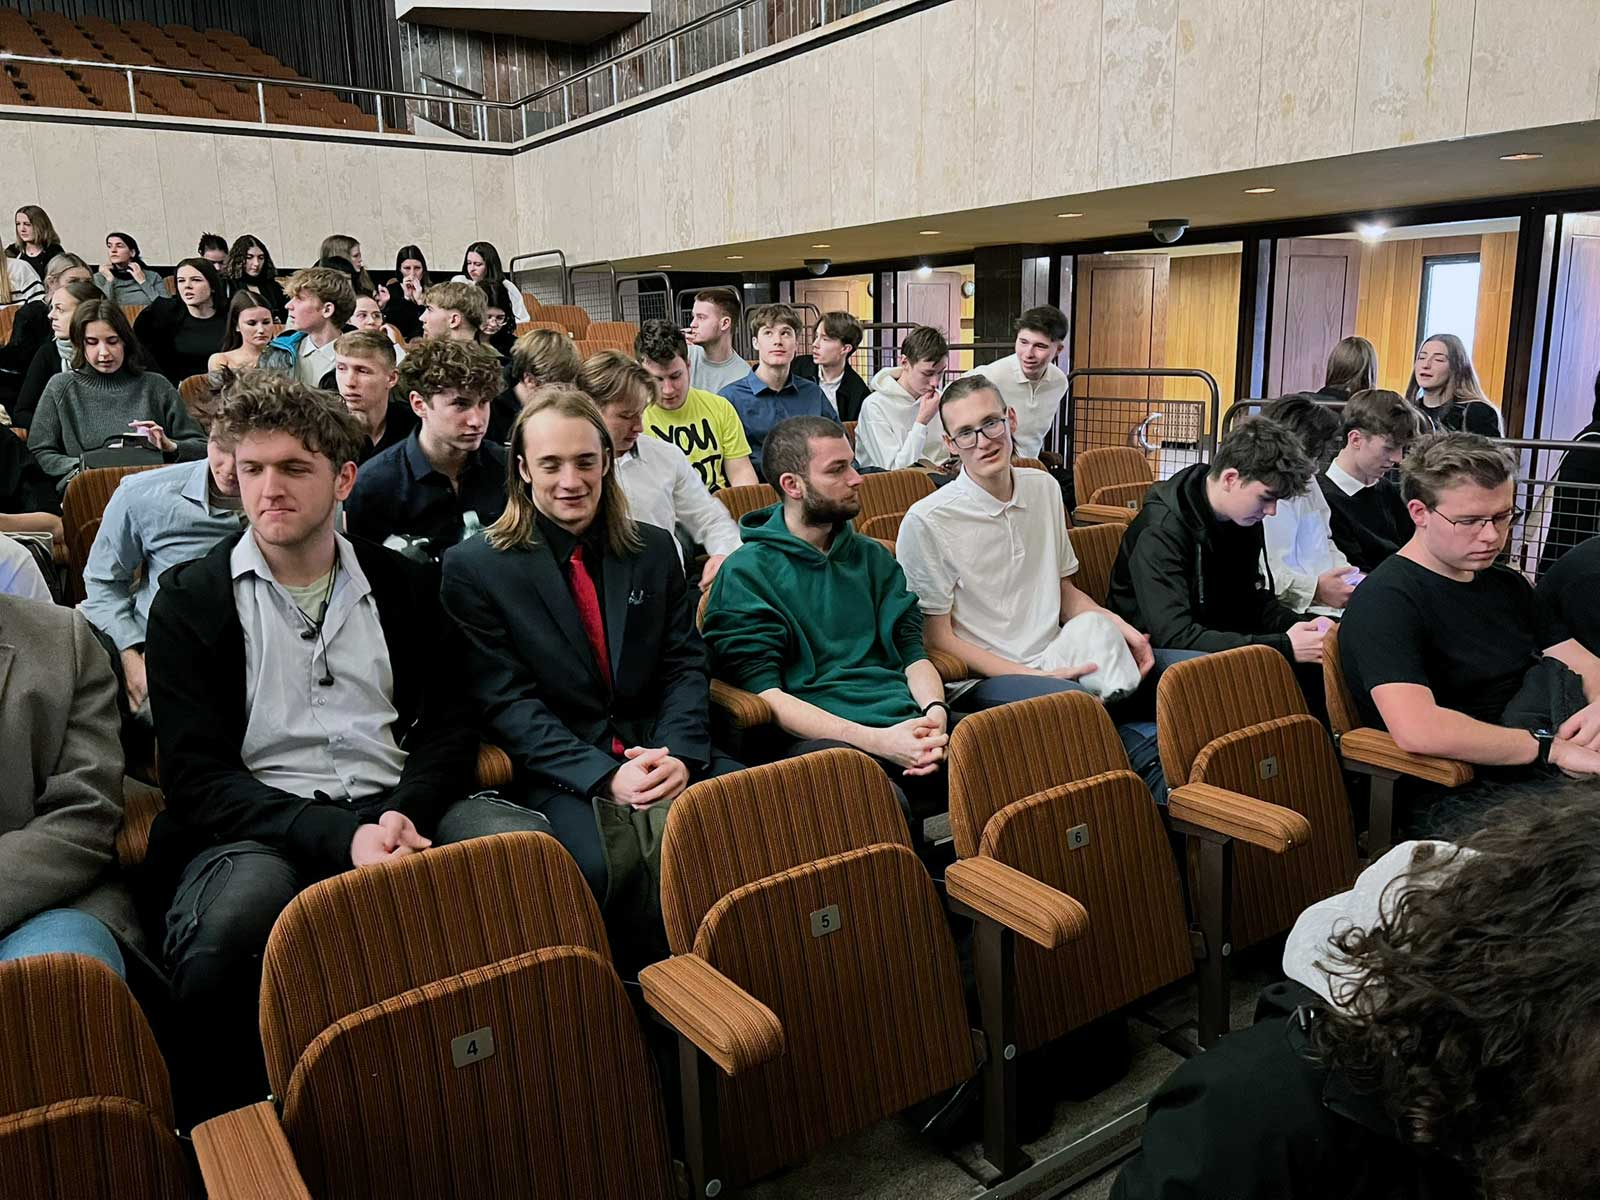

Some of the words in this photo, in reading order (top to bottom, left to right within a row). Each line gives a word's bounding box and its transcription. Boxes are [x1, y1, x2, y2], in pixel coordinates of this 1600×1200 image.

[650, 418, 718, 455] YOU
[1266, 763, 1273, 775] 7
[1075, 831, 1082, 843] 6
[821, 914, 830, 928] 5
[467, 1039, 478, 1056] 4
